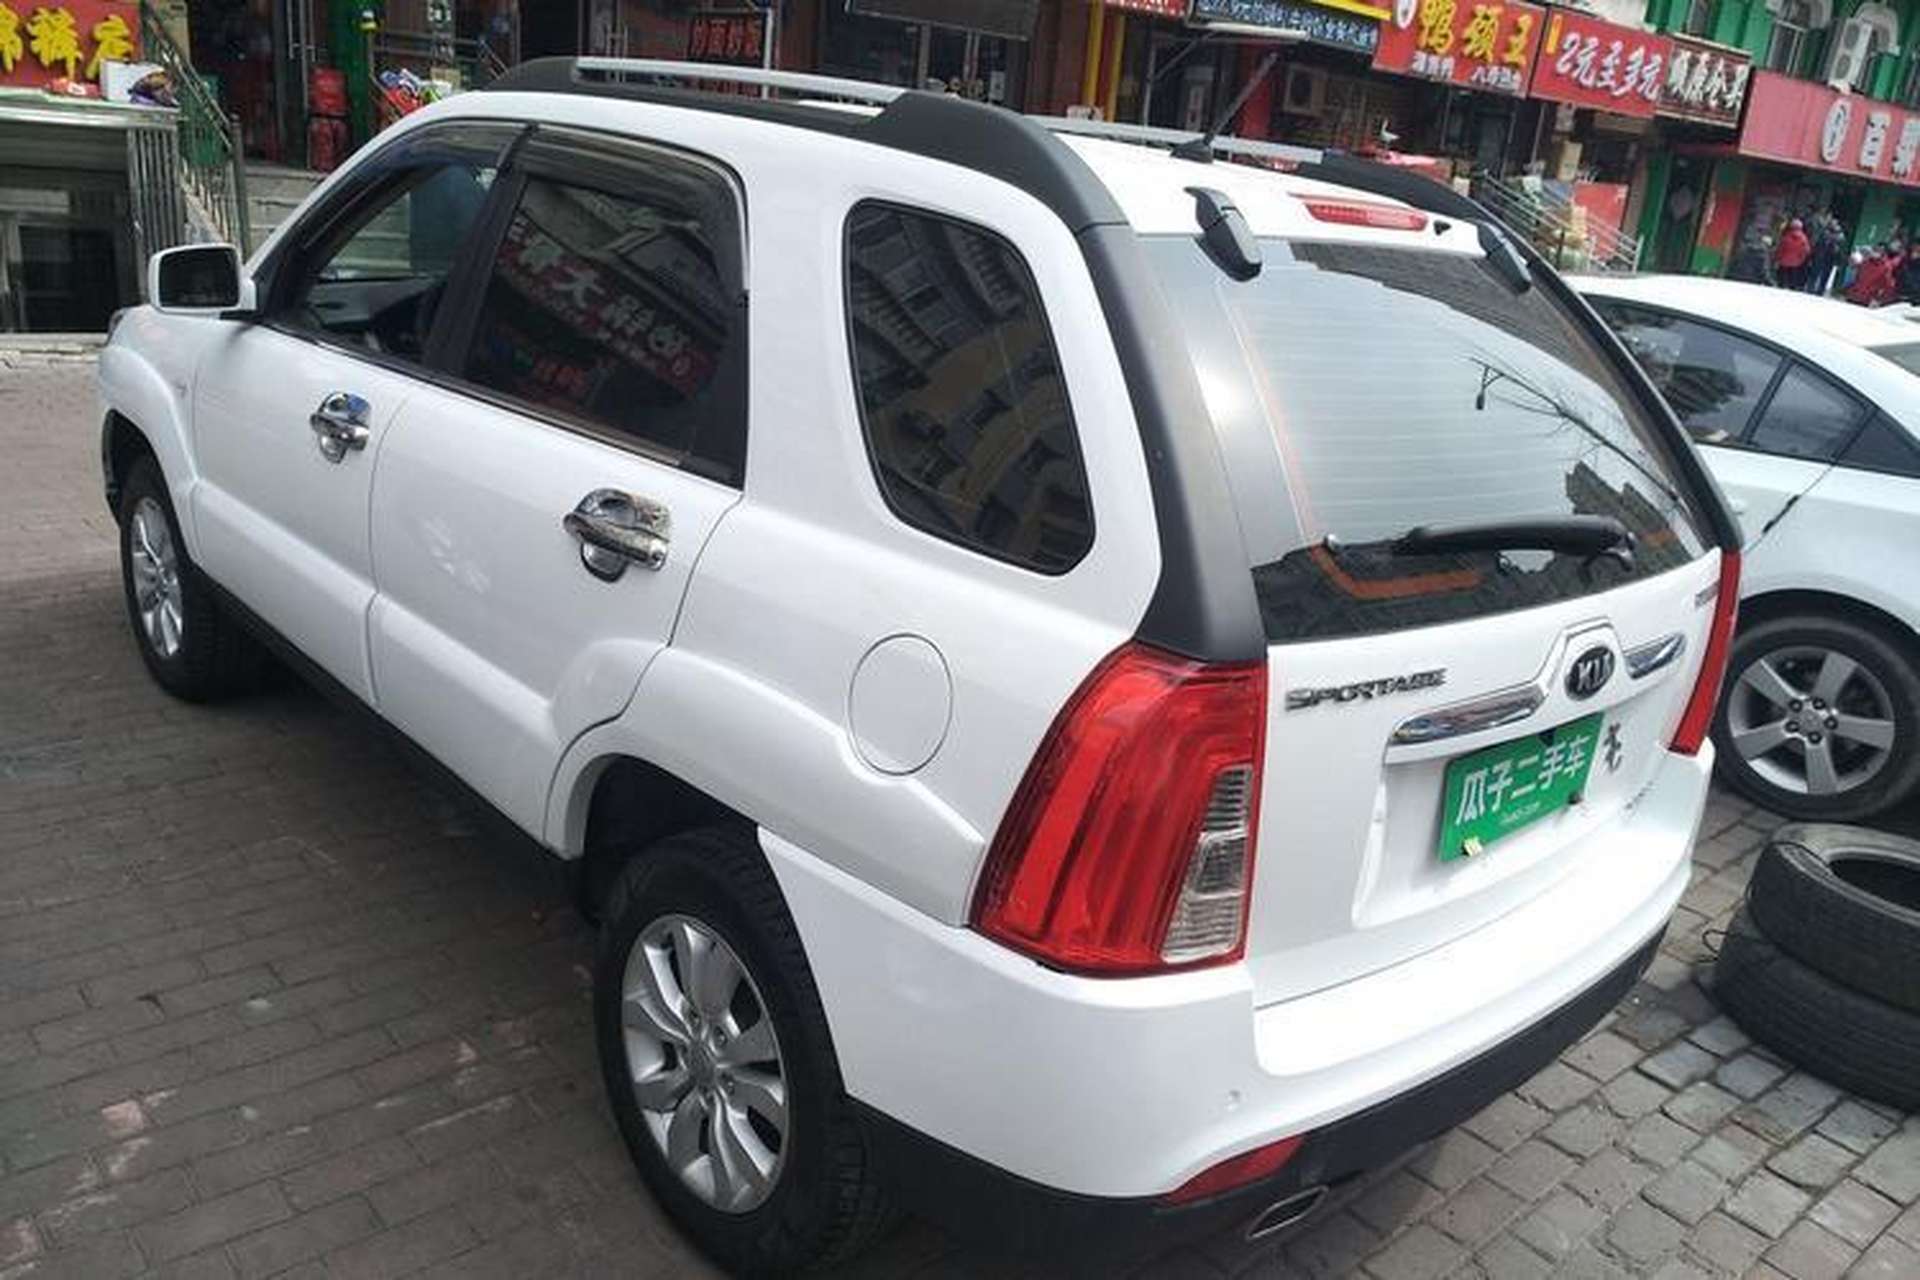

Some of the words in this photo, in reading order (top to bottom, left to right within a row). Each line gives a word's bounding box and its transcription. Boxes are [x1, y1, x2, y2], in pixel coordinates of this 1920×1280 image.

[1285, 667, 1447, 712] SPORTAGE
[1455, 734, 1590, 826] 瓜子二手车
